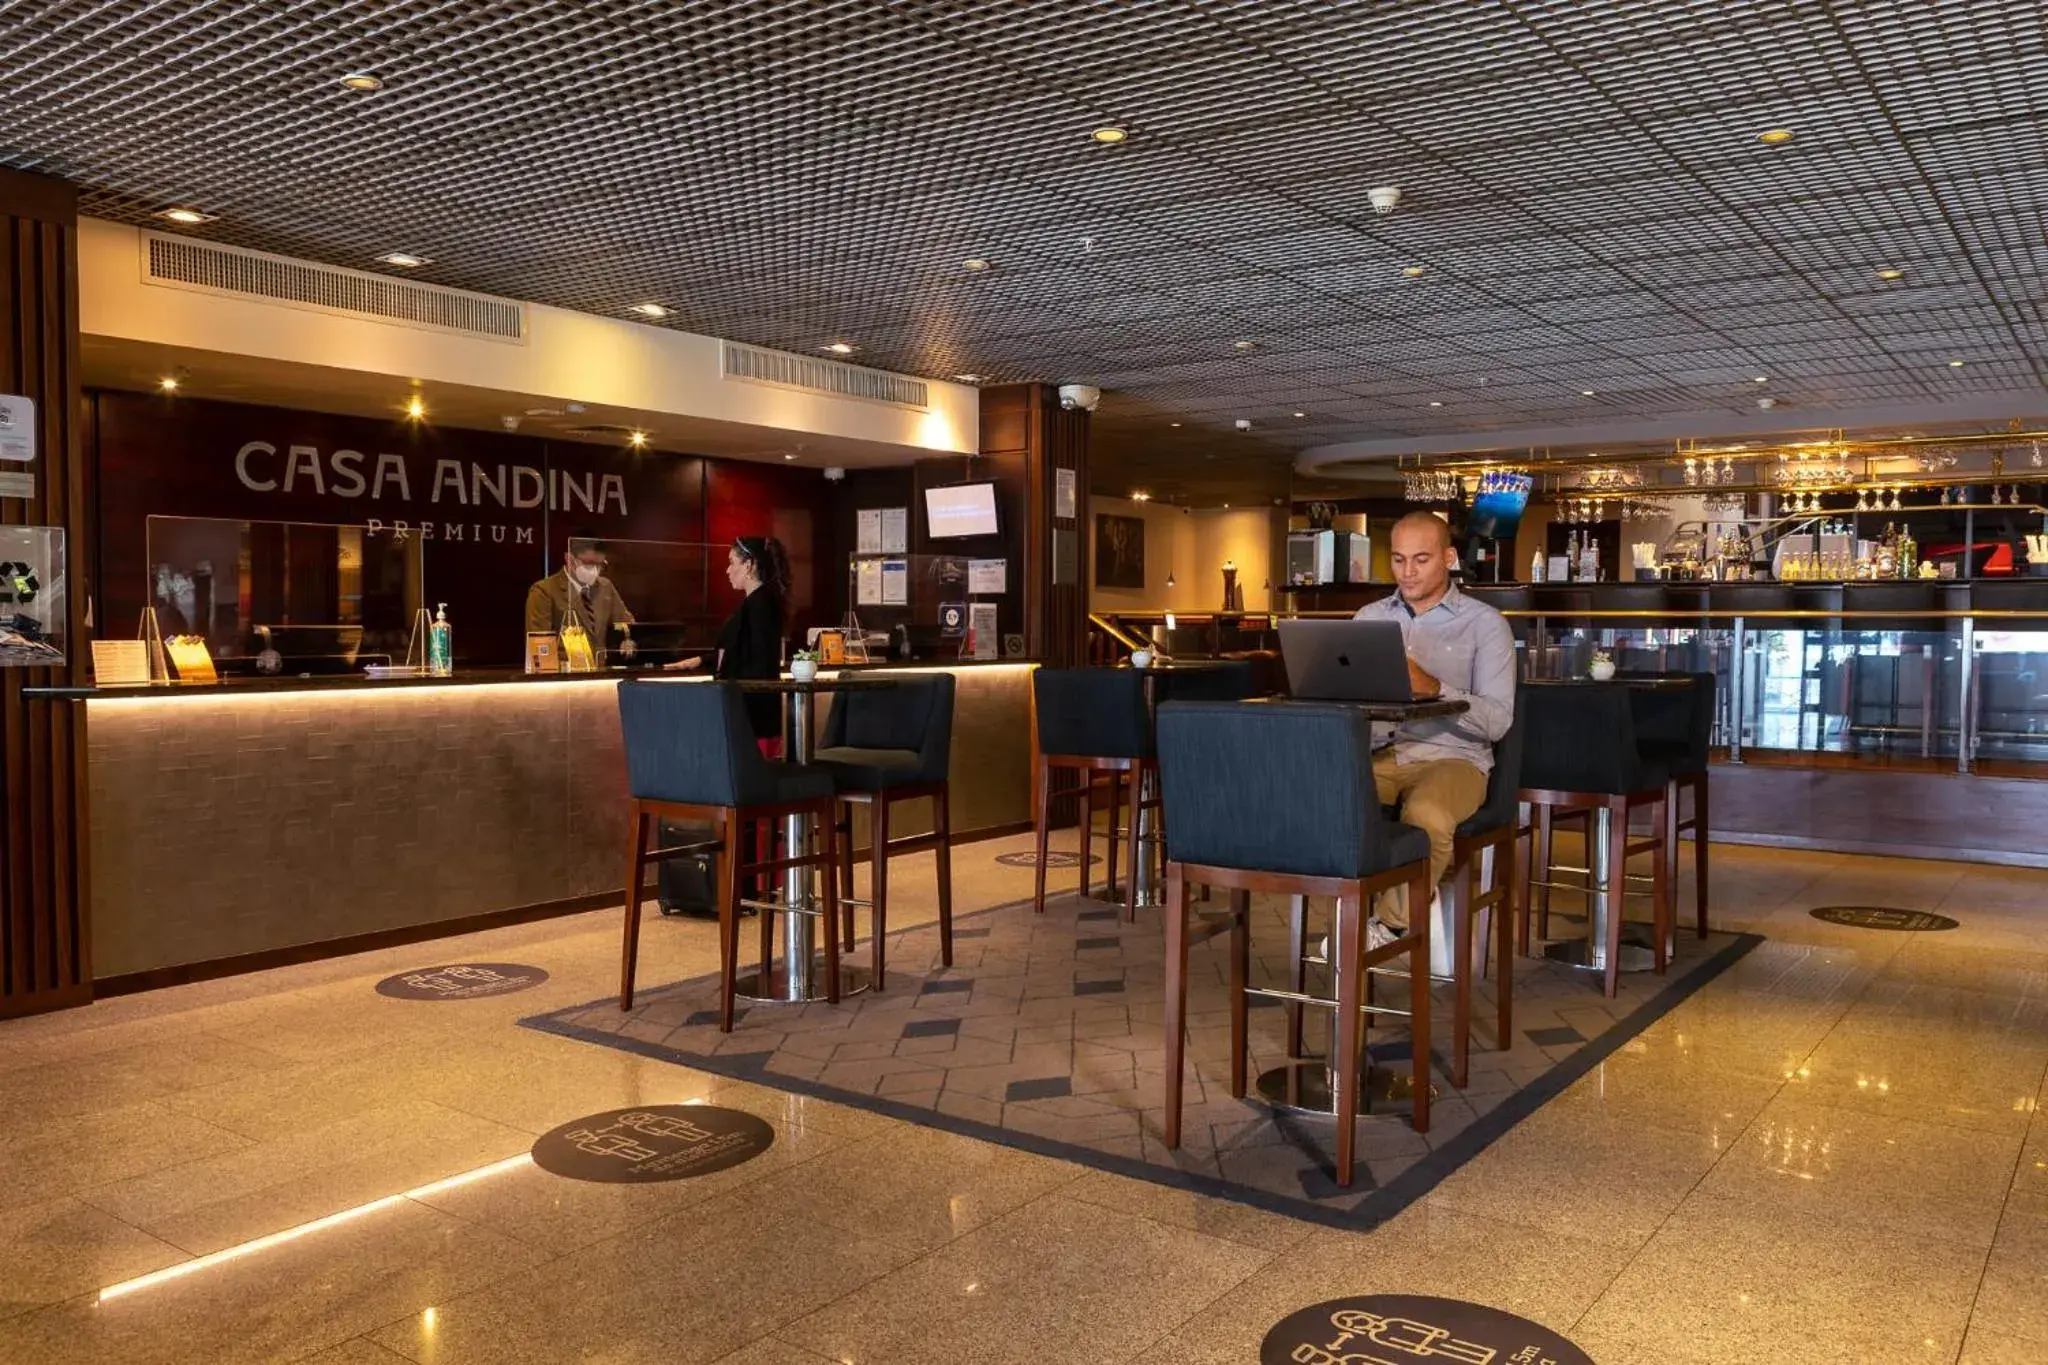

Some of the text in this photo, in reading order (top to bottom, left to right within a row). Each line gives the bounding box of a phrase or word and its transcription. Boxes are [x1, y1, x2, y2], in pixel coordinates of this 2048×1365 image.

[235, 440, 629, 516] CASA ANDINA
[367, 518, 534, 544] PREMIUM
